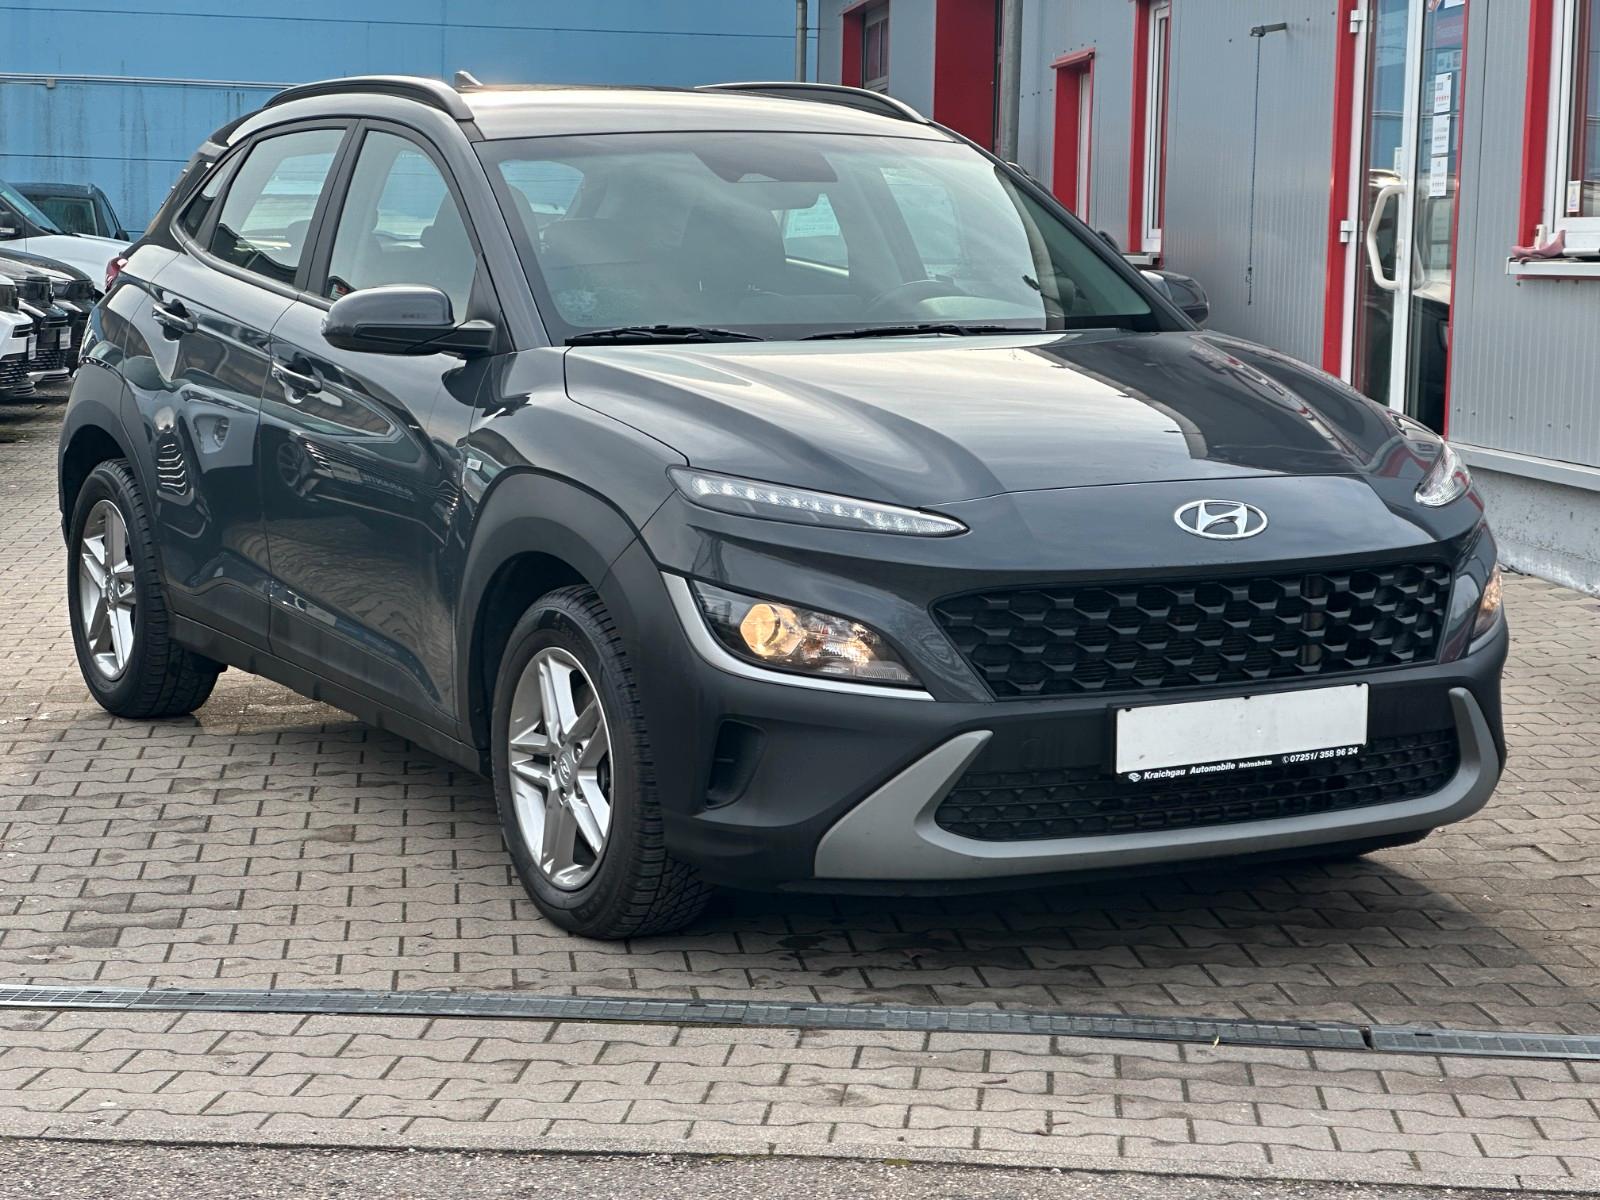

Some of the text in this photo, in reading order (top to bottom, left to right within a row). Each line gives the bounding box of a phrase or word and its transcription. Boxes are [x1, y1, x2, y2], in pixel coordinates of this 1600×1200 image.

[1143, 769, 1186, 780] Kraichgau
[1190, 763, 1236, 775] Automobile
[1290, 752, 1318, 763] 07251/
[1320, 750, 1334, 759] 358
[1336, 748, 1346, 757] 96
[1347, 746, 1359, 755] 24
